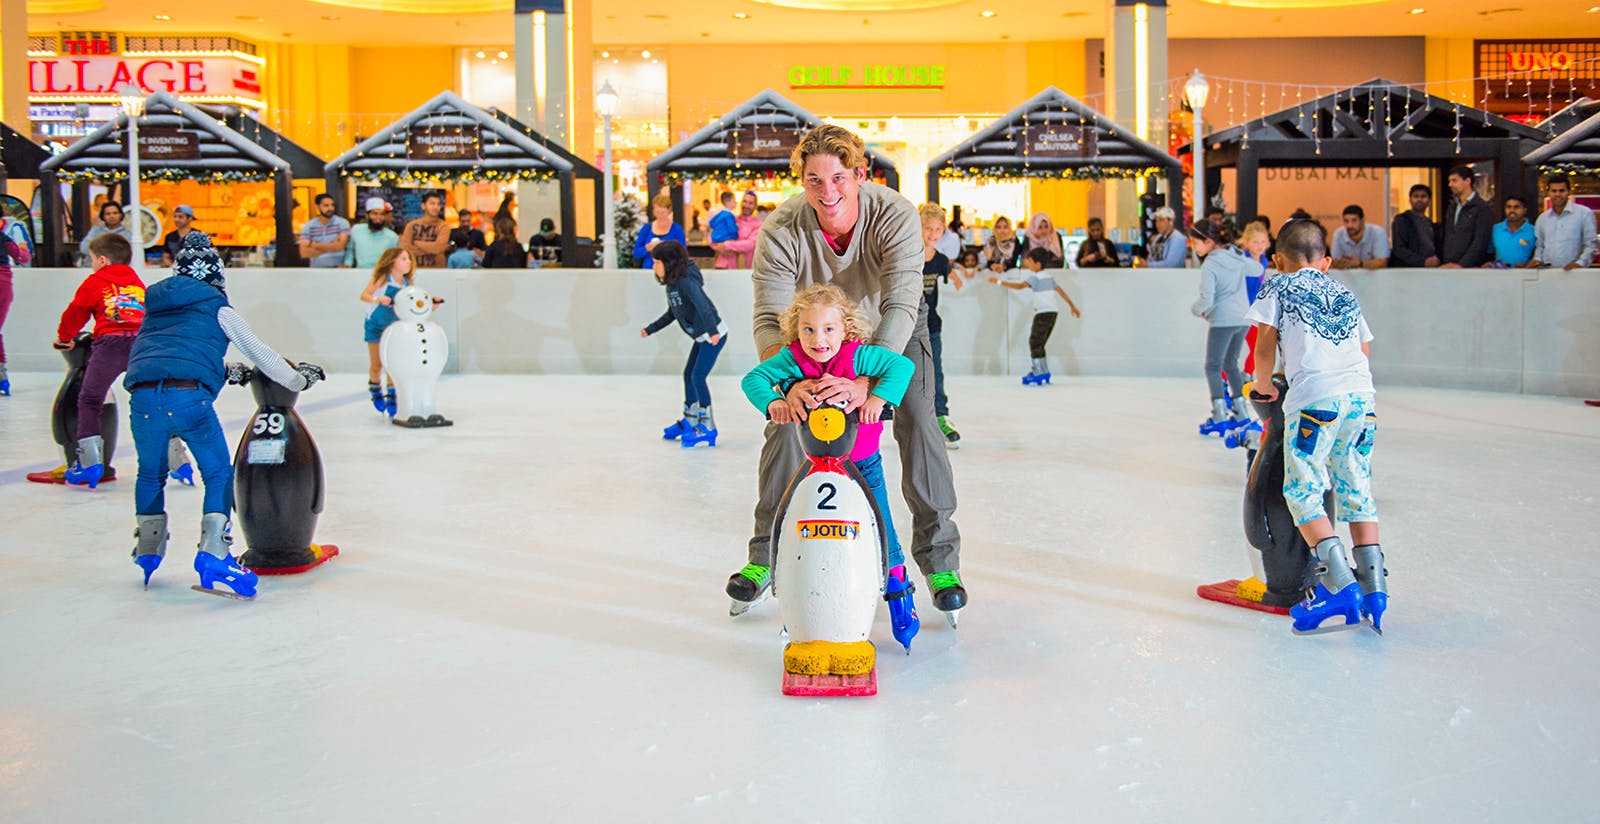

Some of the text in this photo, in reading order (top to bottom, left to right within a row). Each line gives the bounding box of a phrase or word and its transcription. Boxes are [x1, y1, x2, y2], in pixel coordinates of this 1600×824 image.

[63, 39, 111, 55] THE
[1506, 51, 1572, 72] UNO
[28, 60, 207, 93] ILLAGE
[788, 65, 945, 86] GOLF HOUSE
[41, 108, 77, 119] Parking
[147, 137, 189, 145] INVENTING
[416, 136, 473, 144] THE INVENTING
[1038, 133, 1074, 141] CHELSEA
[433, 145, 457, 153] ROOM
[1034, 142, 1079, 151] BEAUTIQUE
[1265, 168, 1380, 181] DUBAI MAL
[417, 323, 425, 333] 3
[253, 412, 285, 435] 59
[817, 482, 837, 510] 2
